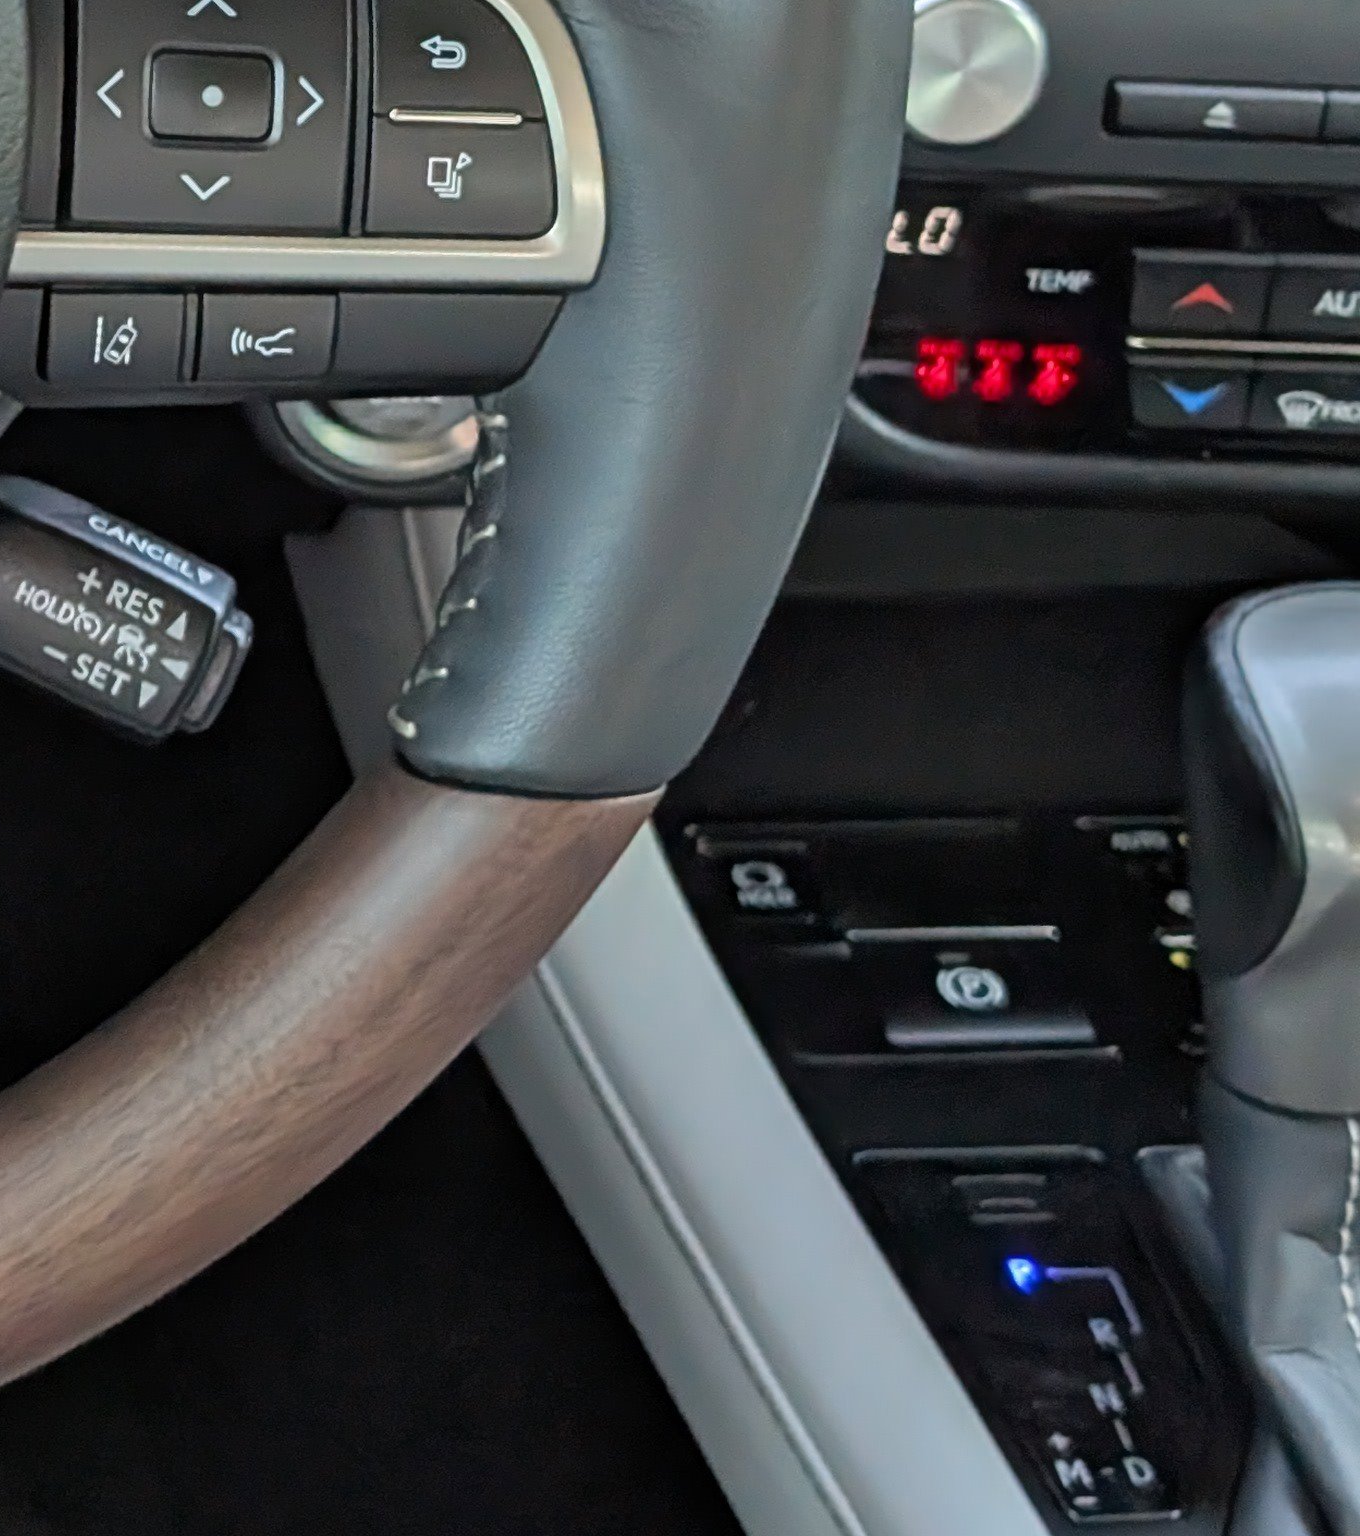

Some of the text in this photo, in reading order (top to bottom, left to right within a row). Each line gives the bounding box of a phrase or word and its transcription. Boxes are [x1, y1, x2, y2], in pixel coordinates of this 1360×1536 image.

[1026, 268, 1094, 293] TEMP
[88, 514, 194, 578] CANCEL
[14, 580, 76, 625] HOLD
[106, 579, 164, 625] RES
[71, 653, 130, 696] SET
